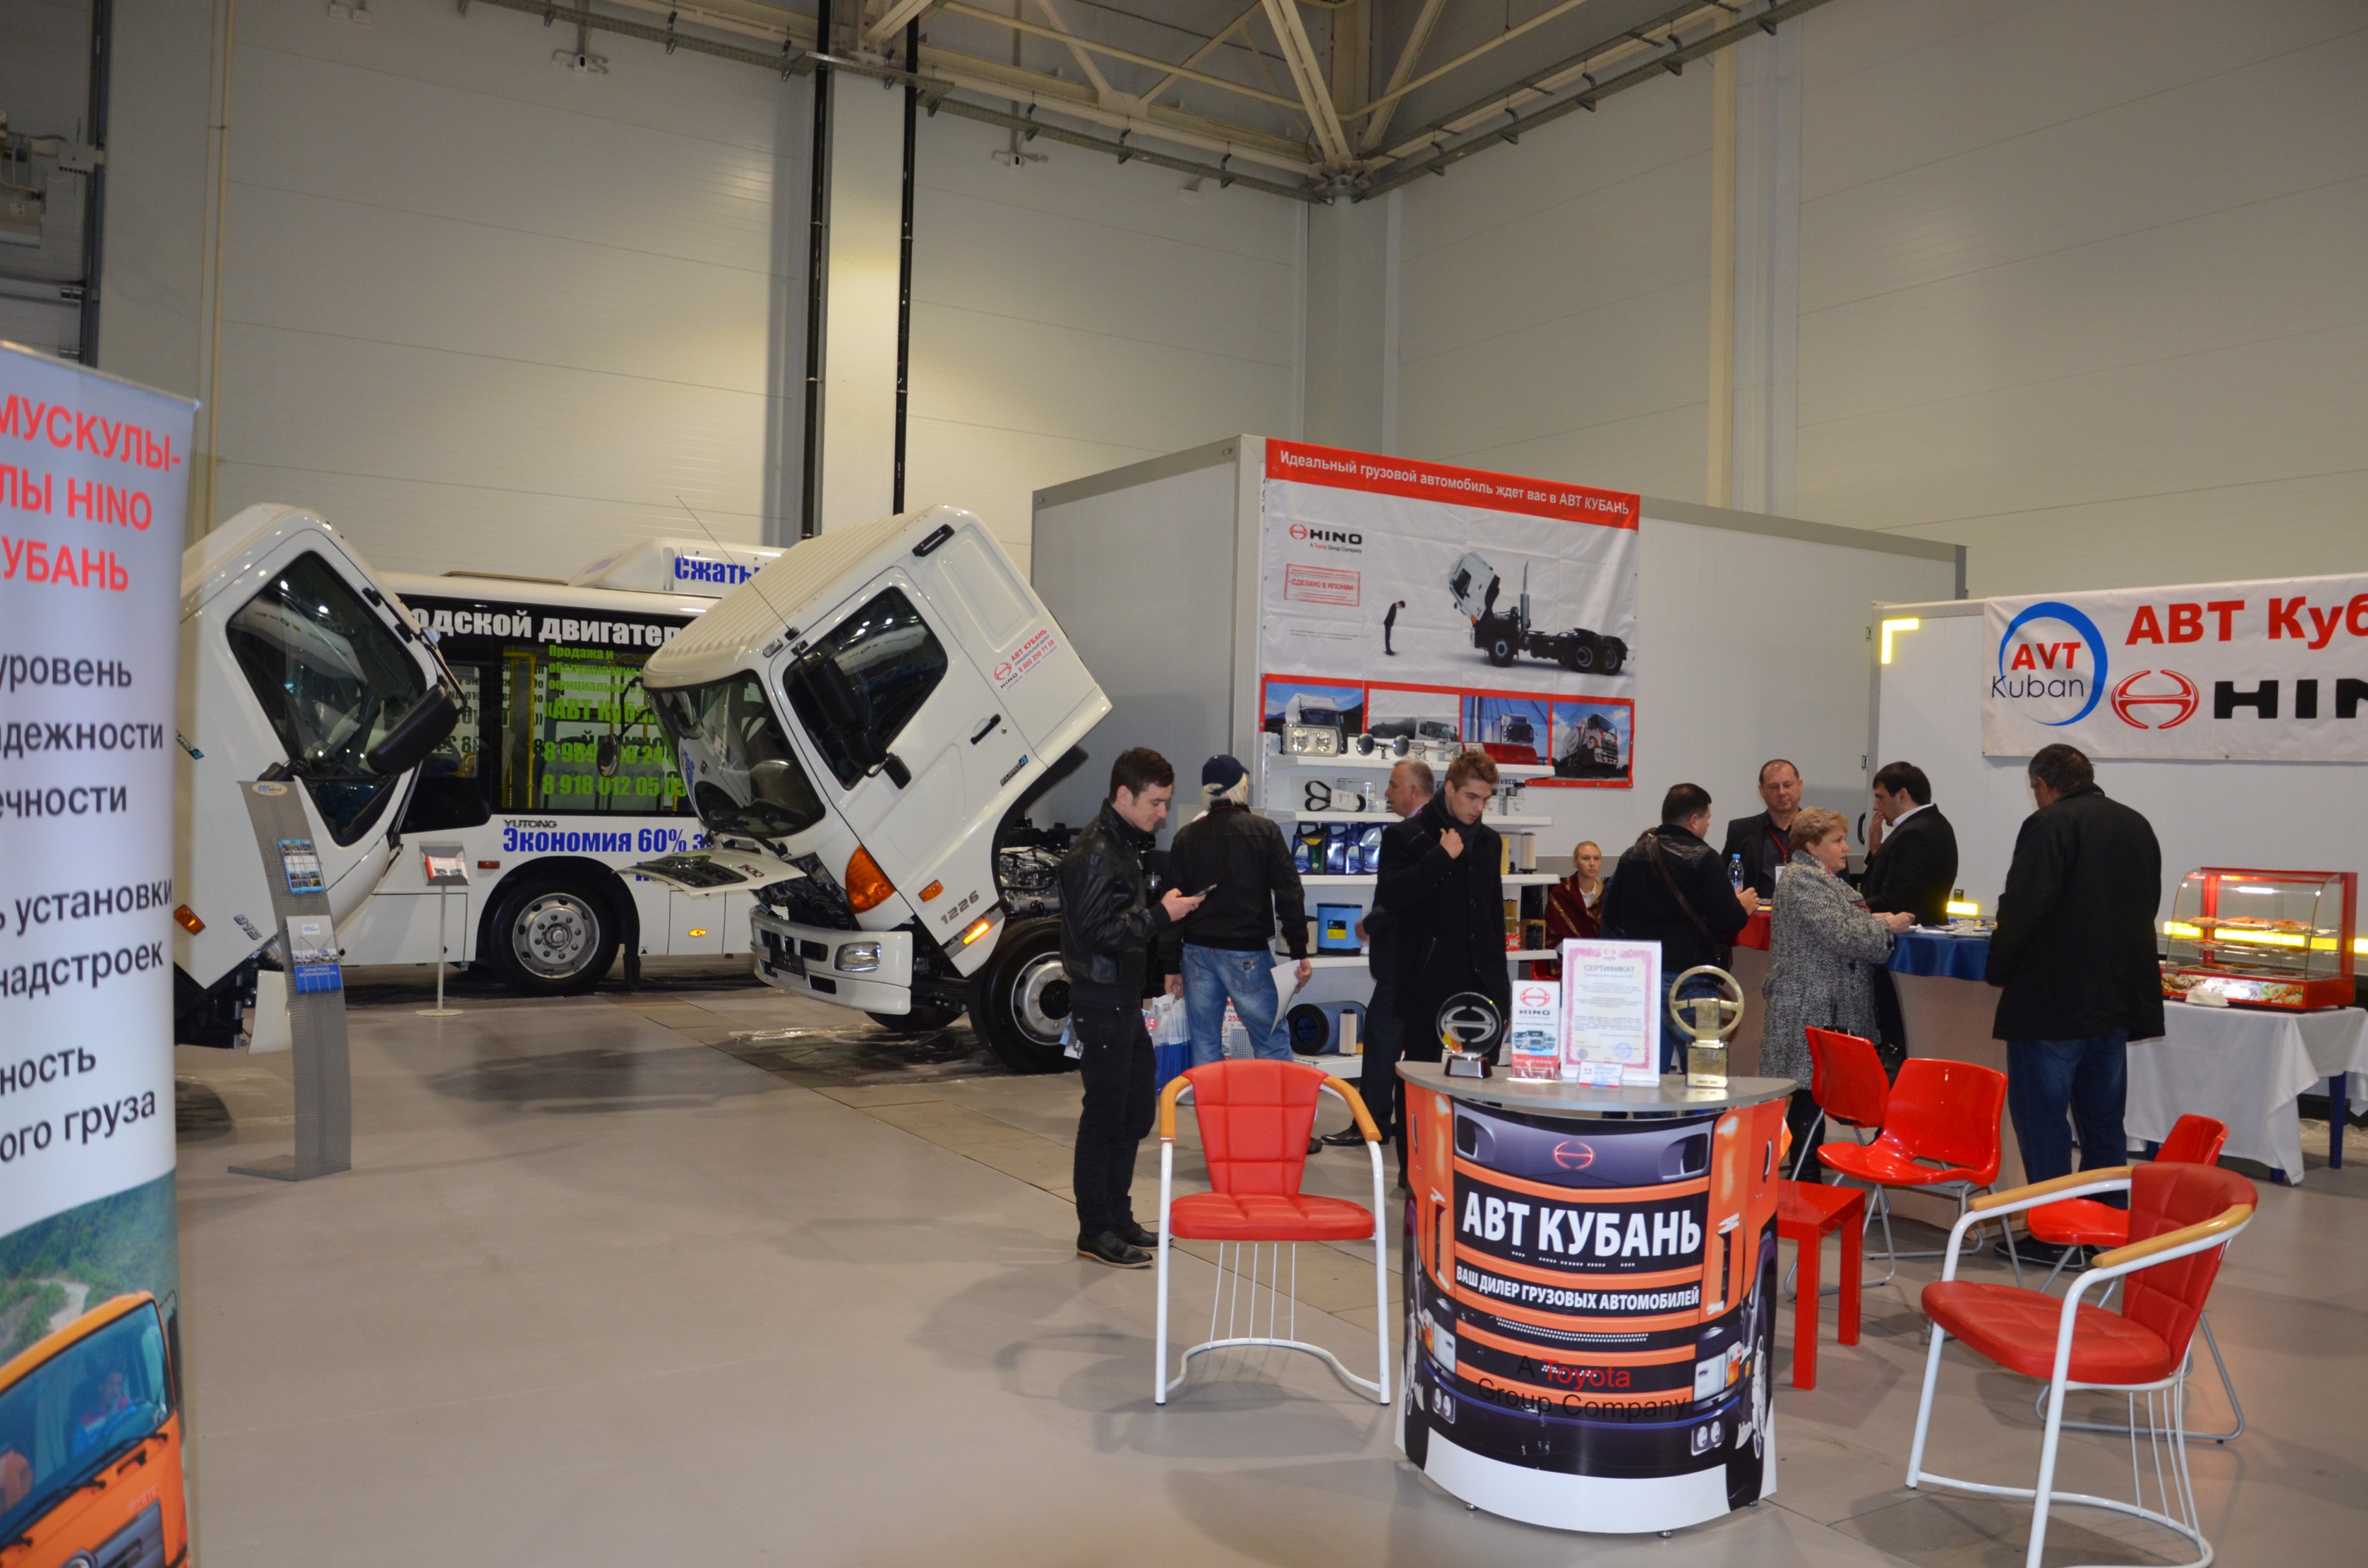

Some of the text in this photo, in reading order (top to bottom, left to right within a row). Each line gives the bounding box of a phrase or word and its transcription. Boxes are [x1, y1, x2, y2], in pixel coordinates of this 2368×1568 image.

[1281, 450, 1629, 515] Идеальный грузовой автомобиль ждет вас в АВТ КУБАНЬ
[67, 478, 153, 530] HINO
[1310, 528, 1362, 545] HINO
[1292, 578, 1321, 587] СДЕЛАНО
[2125, 599, 2245, 646] АВТ
[549, 644, 614, 660] Продажа и
[1011, 648, 1023, 661] АВТ
[1024, 629, 1048, 650] КУБАНЬ
[2011, 641, 2081, 671] AVT
[1000, 673, 1018, 688] HINO
[1991, 673, 2084, 699] Kuban
[544, 741, 556, 762] 8
[542, 774, 555, 795] 8
[559, 775, 594, 796] 918
[598, 776, 630, 796] 012
[636, 776, 660, 797] 05
[503, 819, 557, 828] YUTONG
[503, 828, 632, 853] Экономия
[638, 828, 687, 853] 60%
[16, 877, 173, 936] установки
[941, 890, 979, 925] 1226
[1584, 964, 1635, 973] СЕРТИФИКАТ
[64, 1089, 156, 1145] груза
[1463, 1191, 1701, 1258] АВТ КУБАНЬ
[1456, 1265, 1699, 1310] ВАШ ДИЛЕР ГРУЗОВЫХ АВТОМОБИЛЕЙ
[1517, 1355, 1631, 1390] A Toyota
[1478, 1377, 1686, 1421] Group Company
